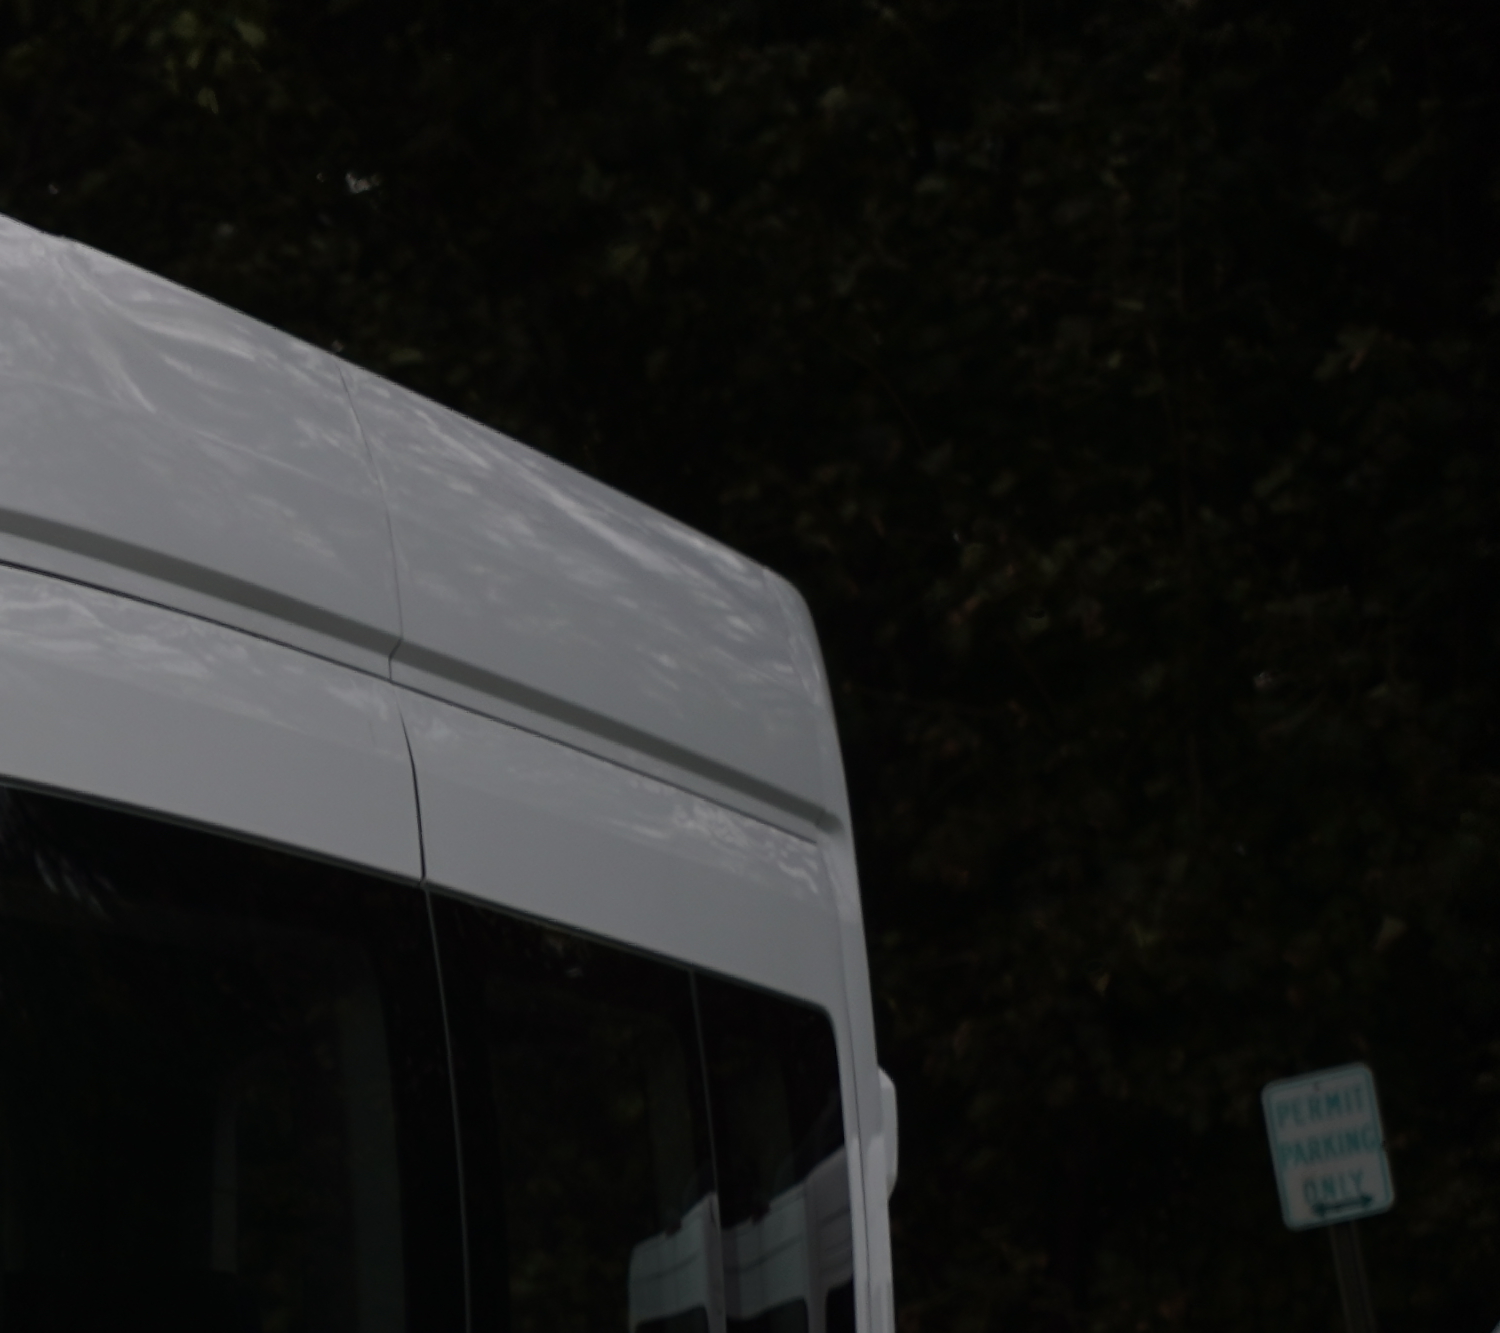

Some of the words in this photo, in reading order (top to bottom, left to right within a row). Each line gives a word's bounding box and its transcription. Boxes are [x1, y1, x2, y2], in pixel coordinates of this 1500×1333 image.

[1275, 1085, 1364, 1127] PERMIT
[1278, 1122, 1379, 1172] PARKING
[1302, 1168, 1364, 1204] ONLY
